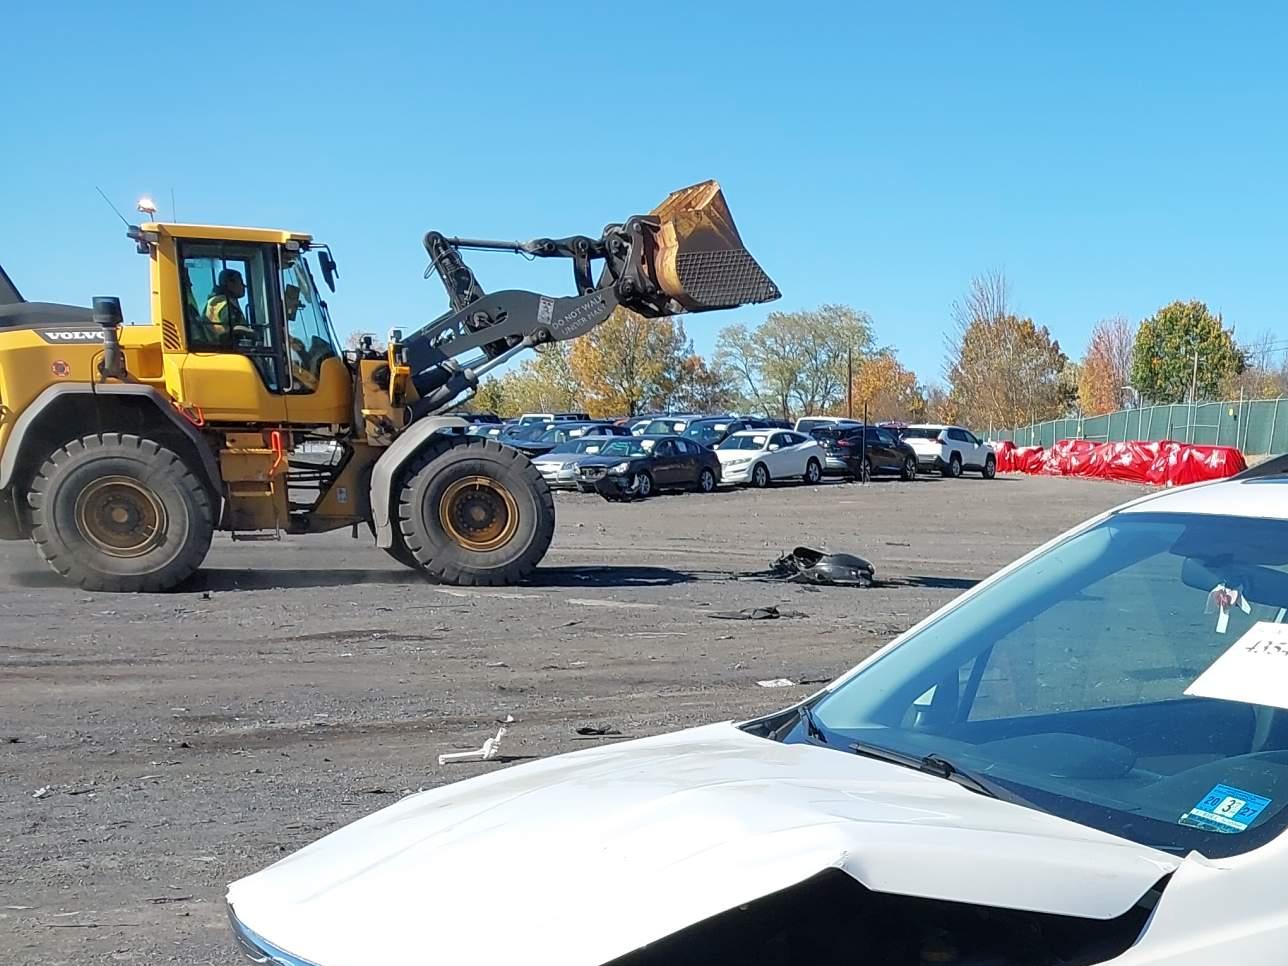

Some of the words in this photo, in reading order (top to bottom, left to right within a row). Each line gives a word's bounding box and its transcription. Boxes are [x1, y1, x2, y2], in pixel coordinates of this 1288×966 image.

[552, 319, 565, 330] DO
[564, 307, 582, 321] NOT
[1204, 795, 1221, 807] 20
[1222, 799, 1236, 813] 3
[1240, 807, 1258, 817] 27
